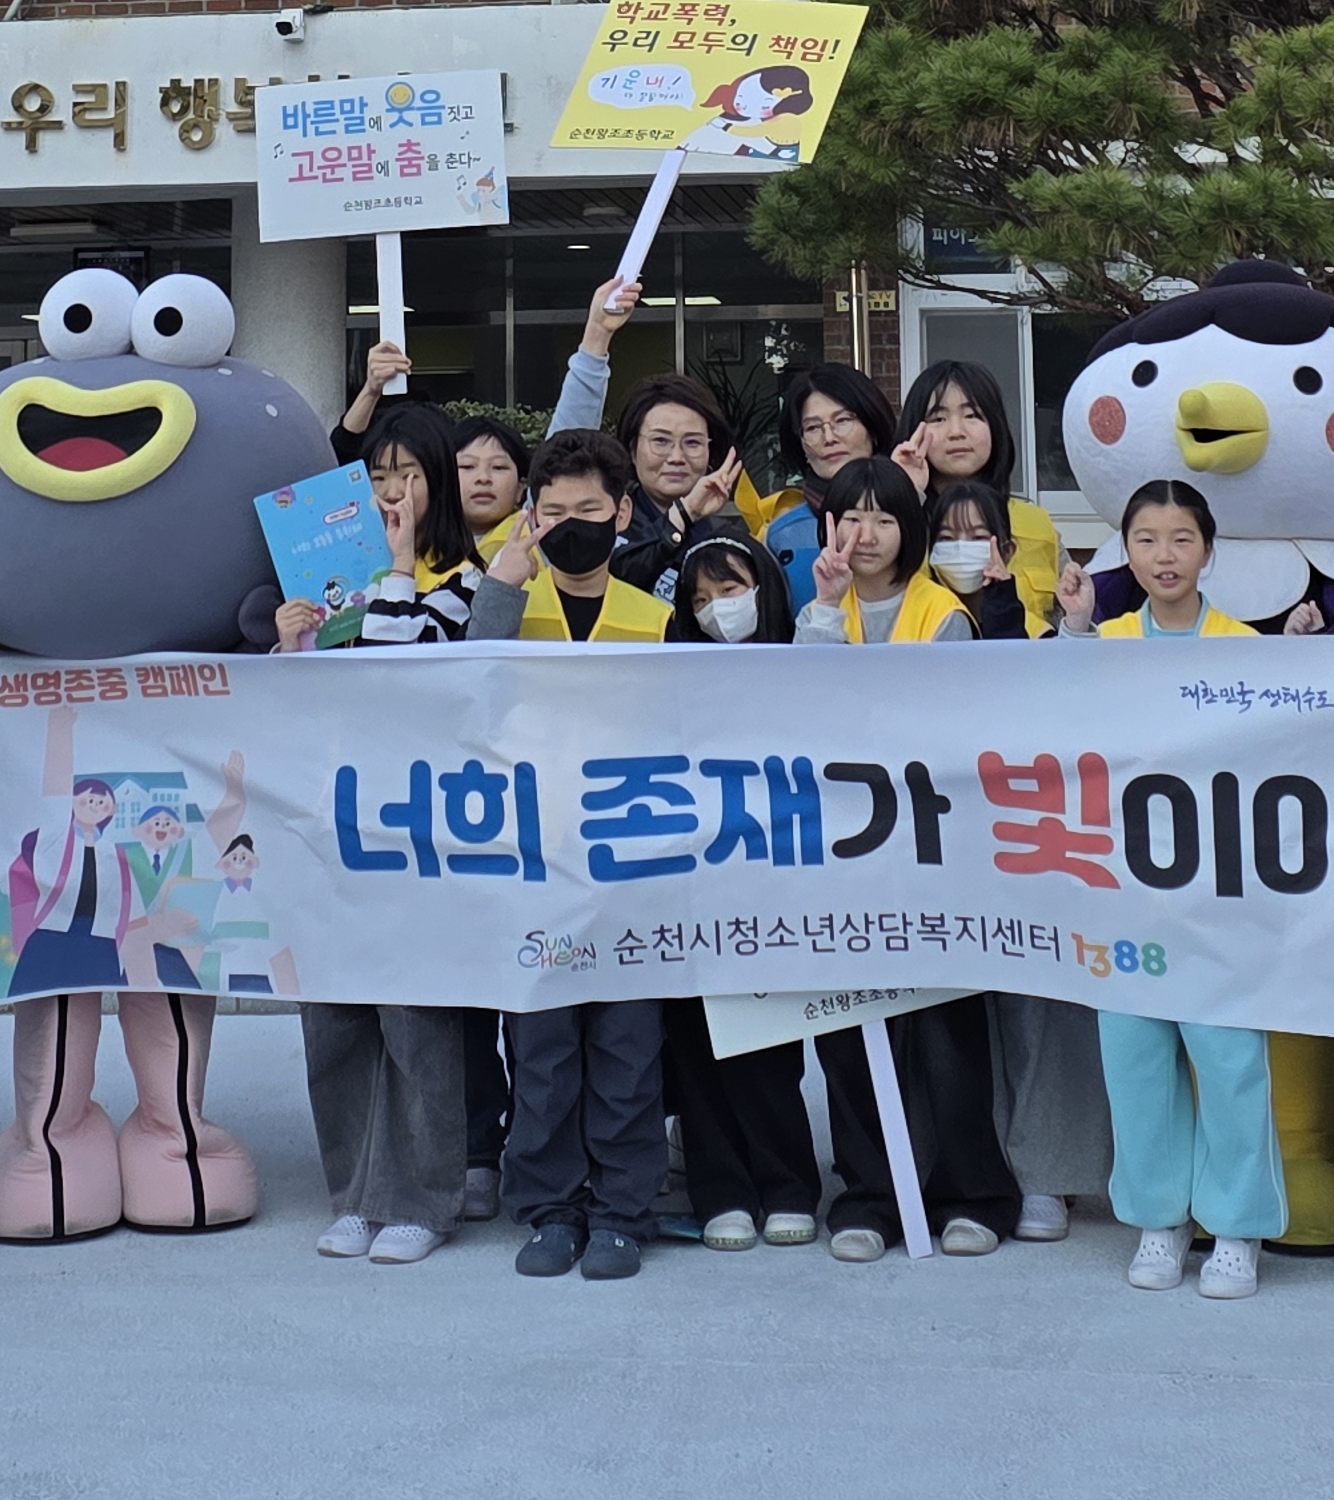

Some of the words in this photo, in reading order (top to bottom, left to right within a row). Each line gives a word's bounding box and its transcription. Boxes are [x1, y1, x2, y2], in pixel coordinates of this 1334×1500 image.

[616, 0, 737, 27] 학교폭력,
[601, 29, 661, 53] 우리
[666, 31, 759, 57] 모두의
[768, 34, 842, 63] 책임!
[1, 80, 129, 153] 우리
[281, 96, 383, 139] 바른말에
[288, 142, 390, 183] 고운말에
[134, 662, 231, 698] 캠페인
[1179, 679, 1256, 714] 대한민국
[335, 759, 547, 883] 너희
[579, 754, 952, 883] 존재가
[613, 911, 1062, 966] 순천시청소년상담복지센터
[1070, 932, 1168, 978] 1388
